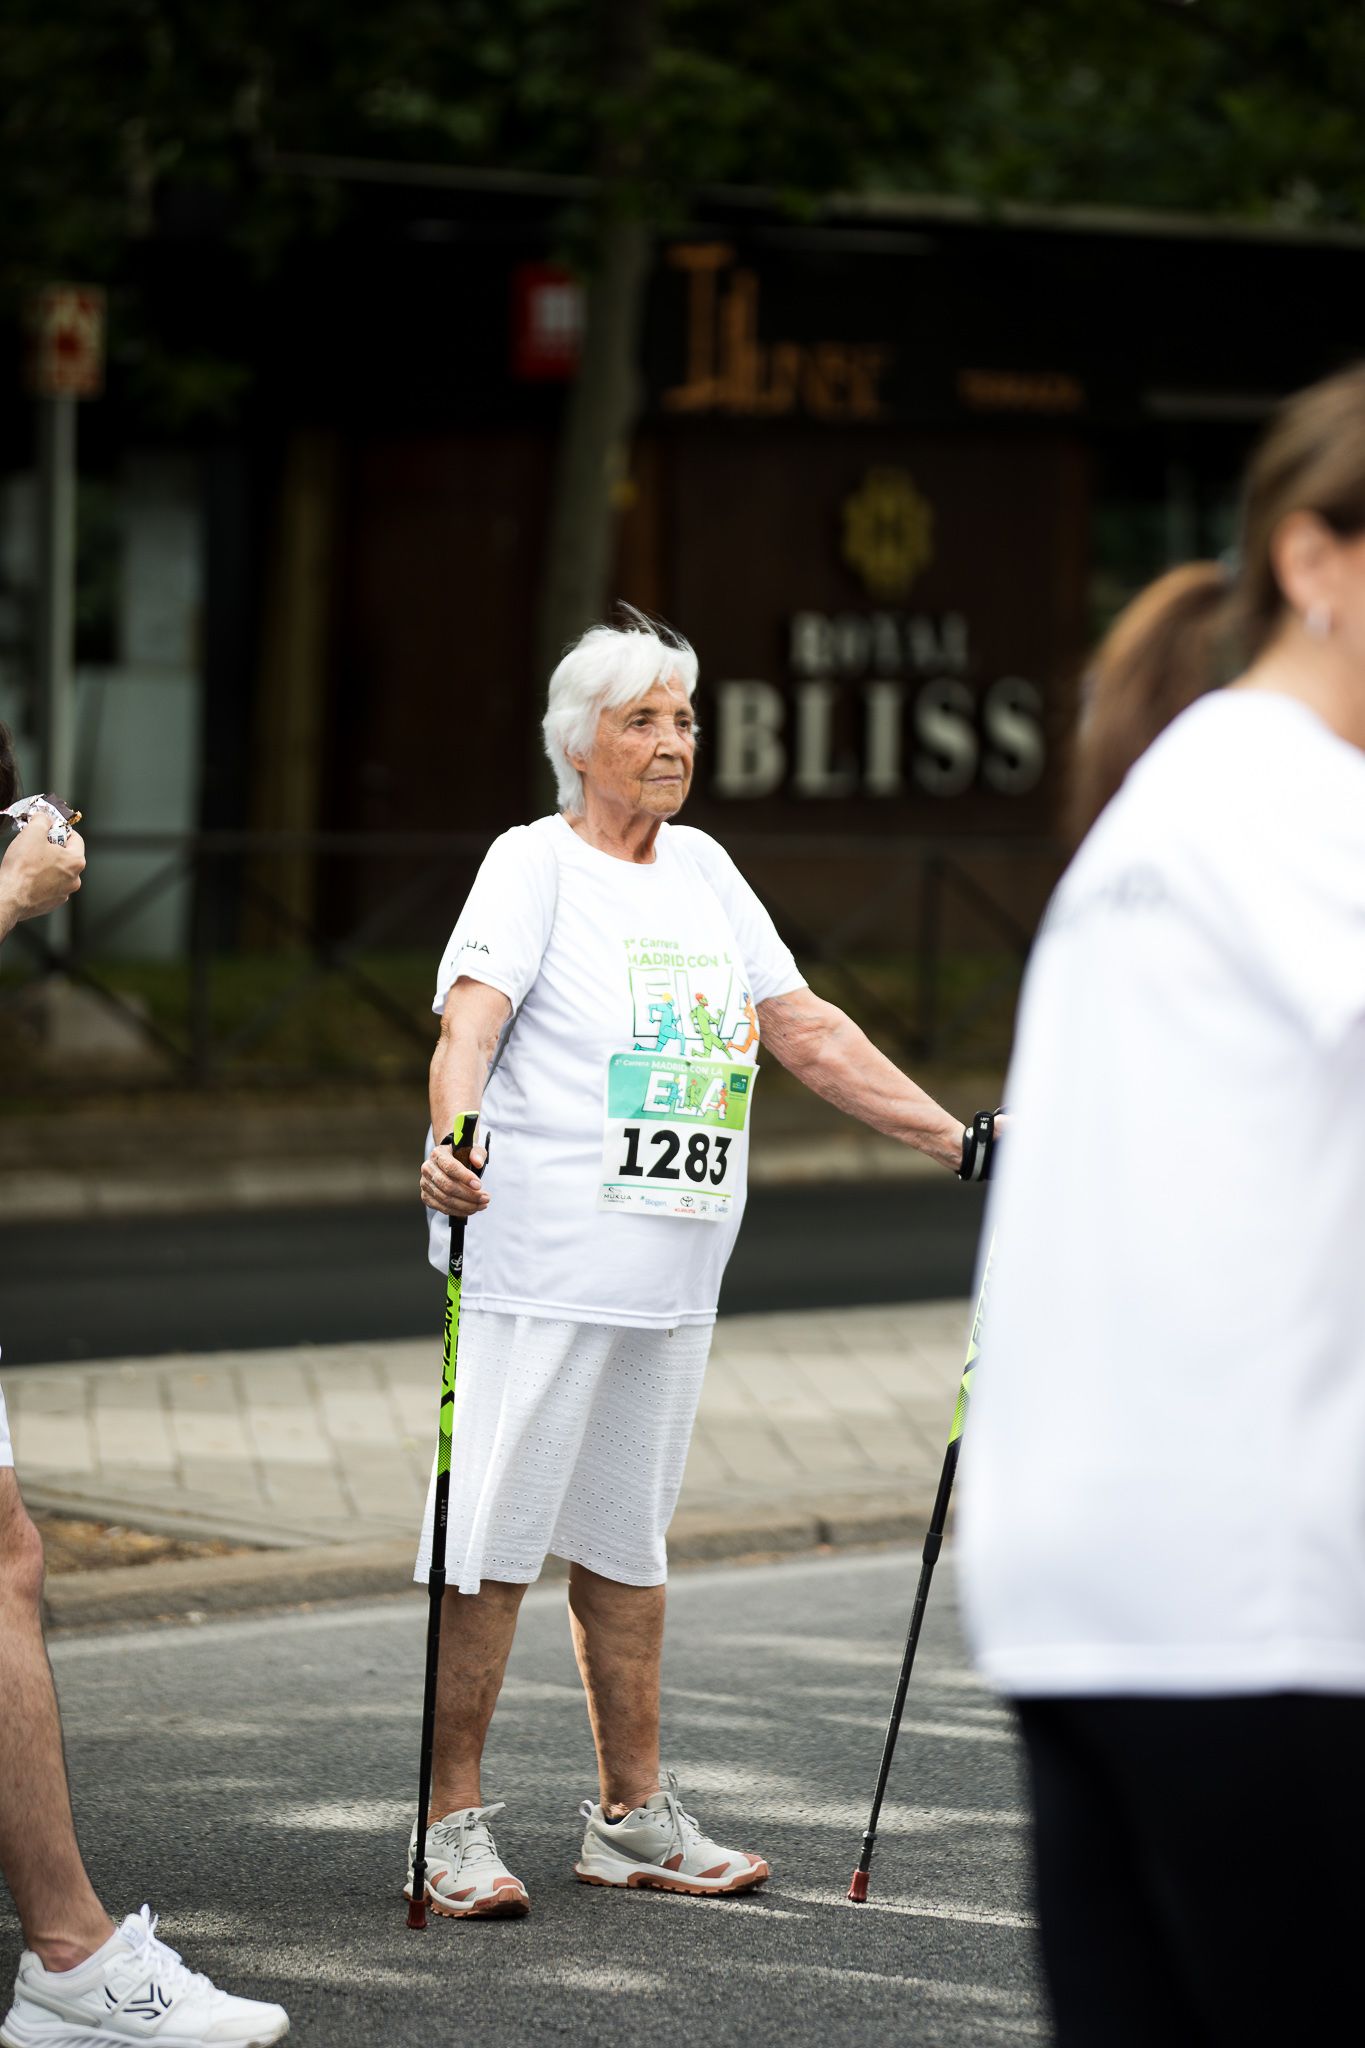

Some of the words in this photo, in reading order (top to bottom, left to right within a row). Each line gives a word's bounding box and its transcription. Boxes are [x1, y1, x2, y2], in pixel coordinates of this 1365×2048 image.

[714, 677, 1046, 799] BLISS
[640, 938, 680, 950] Carrera
[687, 954, 719, 968] CON
[651, 1060, 688, 1072] MADRID
[690, 1065, 710, 1075] CON
[642, 1070, 729, 1121] ELA
[980, 1122, 988, 1130] M
[618, 1127, 733, 1186] 1283
